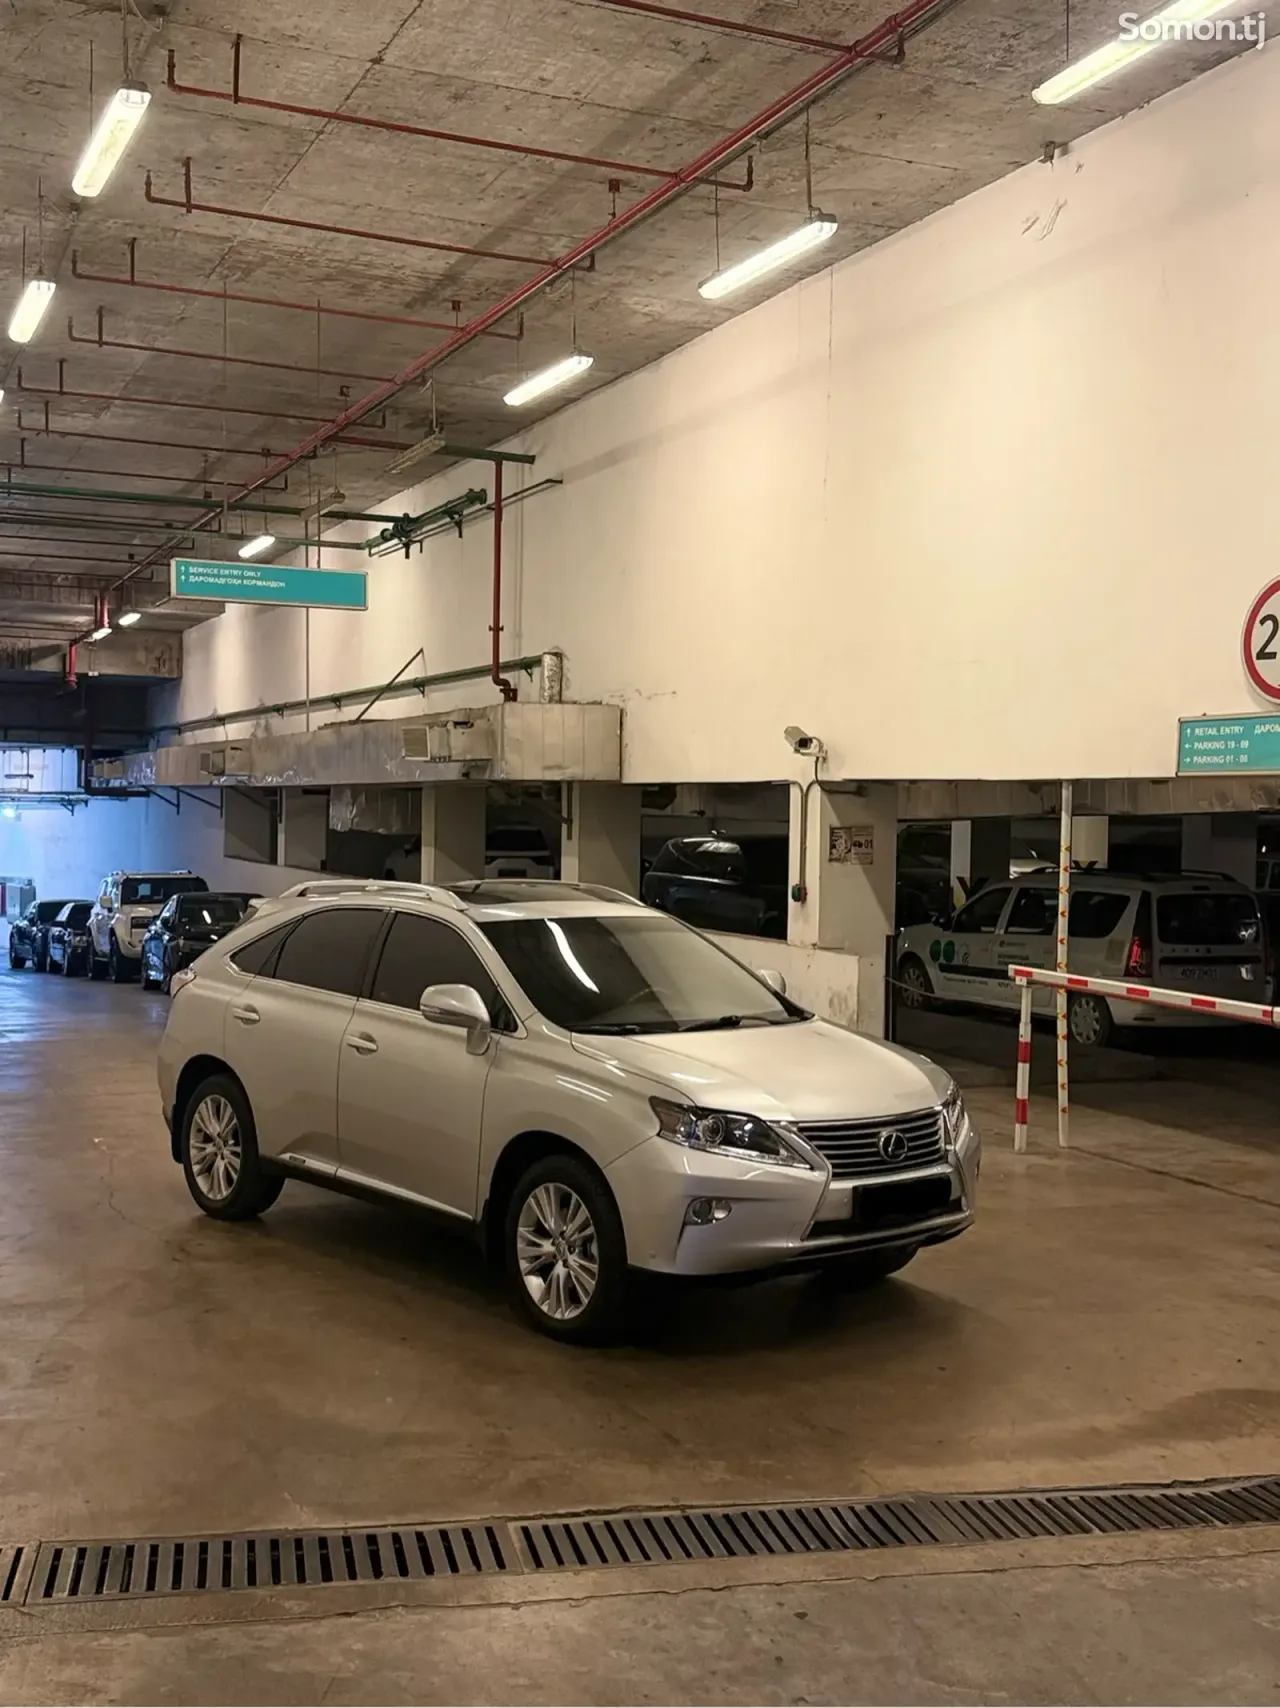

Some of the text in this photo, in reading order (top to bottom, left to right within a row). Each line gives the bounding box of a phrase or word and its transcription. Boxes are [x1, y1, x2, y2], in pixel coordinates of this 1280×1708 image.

[189, 566, 218, 575] SERVICE
[243, 570, 261, 578] ONLY
[1194, 725, 1244, 736] RETAIL ENTRY
[1193, 740, 1225, 750] PARKING
[1192, 754, 1225, 764] PARKING
